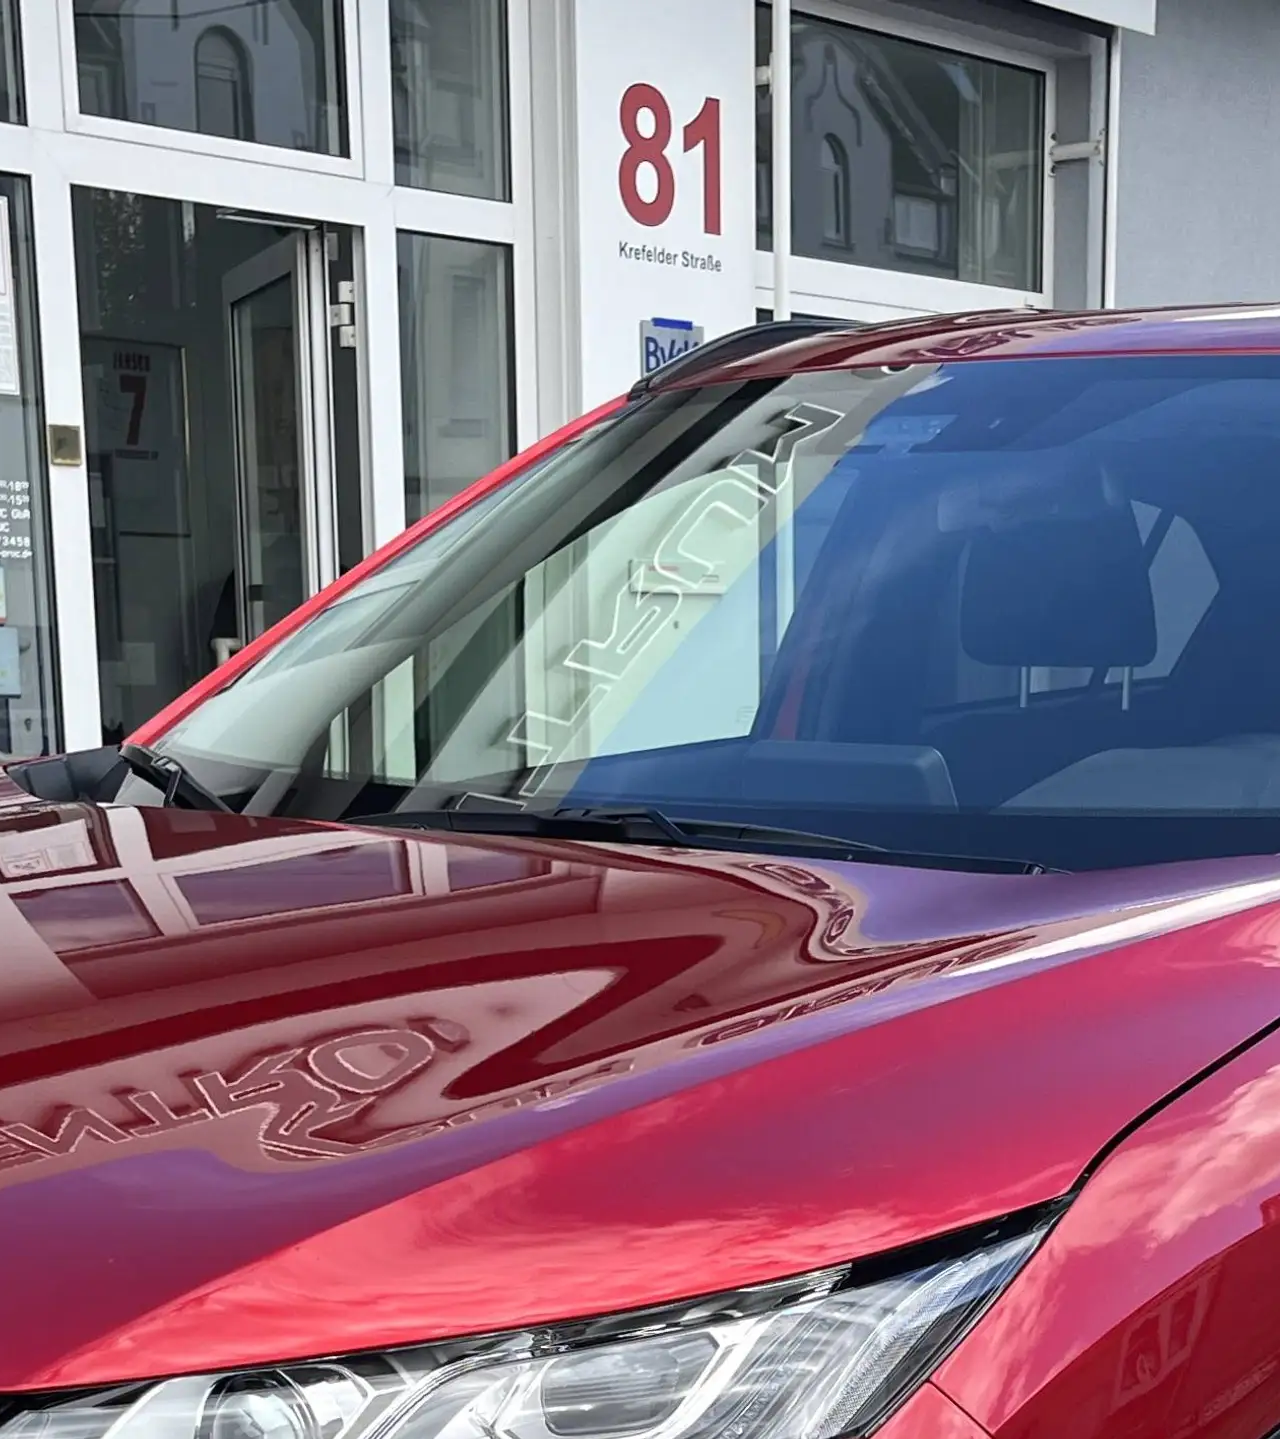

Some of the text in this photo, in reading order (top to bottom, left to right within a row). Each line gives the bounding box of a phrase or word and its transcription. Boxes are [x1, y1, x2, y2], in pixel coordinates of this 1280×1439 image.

[618, 82, 722, 236] 81
[618, 240, 723, 272] Krefelder Straße
[119, 373, 147, 447] 7
